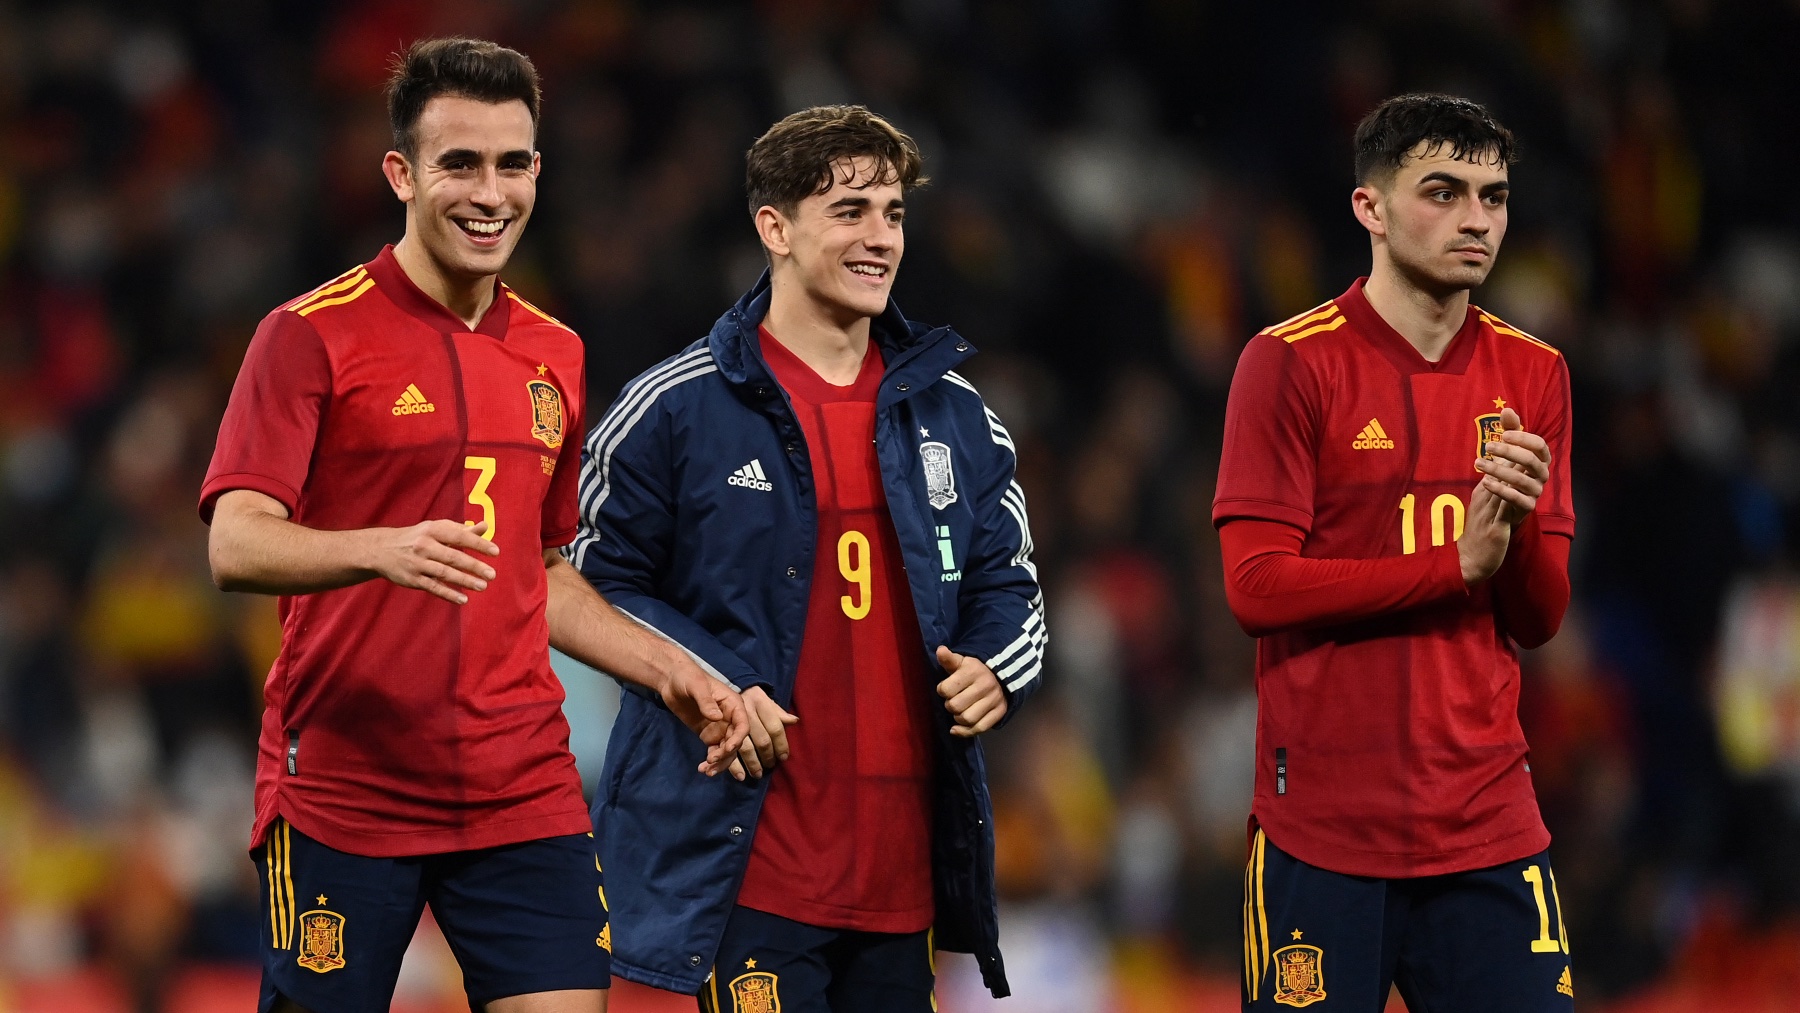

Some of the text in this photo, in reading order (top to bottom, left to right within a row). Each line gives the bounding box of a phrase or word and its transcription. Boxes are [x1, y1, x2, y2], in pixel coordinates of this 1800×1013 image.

[392, 402, 435, 416] adidas
[1352, 437, 1395, 450] adidas
[464, 456, 496, 542] 3
[728, 475, 773, 492] adidas
[1399, 493, 1465, 555] 10
[837, 530, 872, 620] 9
